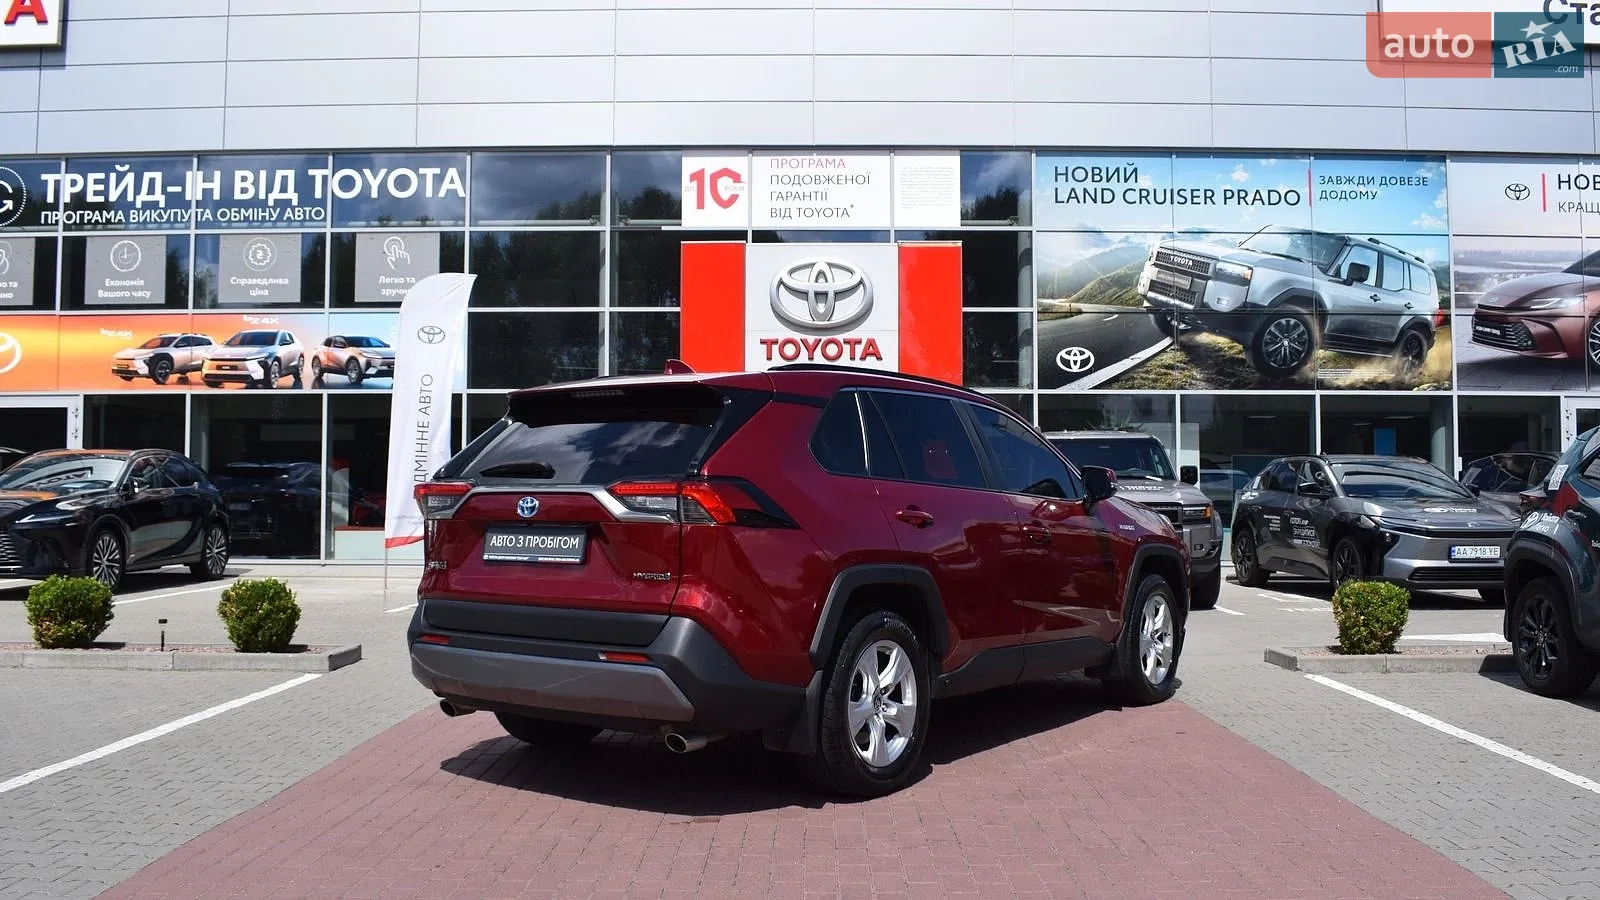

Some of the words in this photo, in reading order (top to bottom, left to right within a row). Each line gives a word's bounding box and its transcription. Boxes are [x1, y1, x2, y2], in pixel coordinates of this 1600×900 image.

[770, 158, 846, 168] ПРОГРАМА
[770, 172, 871, 187] ПОДОВЖЕНОЇ
[1054, 162, 1138, 183] НОВИЙ
[41, 165, 221, 208] ТРЕЙД-ІН
[234, 169, 298, 206] ВІД
[308, 168, 466, 199] TOYOTA
[1319, 175, 1375, 187] ЗАВЖДИ
[1379, 176, 1429, 187] ДОВЕЗЕ
[1557, 173, 1600, 190] НОВ
[770, 188, 829, 201] ГАРАНТІЇ
[1054, 187, 1115, 204] LAND
[1122, 188, 1216, 205] CRUISER
[1223, 189, 1301, 206] PRADO
[1319, 190, 1378, 201] ДОДОМУ
[41, 210, 125, 225] ПРОГРАМА
[130, 209, 192, 224] ВИКУПУ
[194, 208, 213, 222] ТА
[217, 207, 279, 222] ОБМІНУ
[283, 206, 325, 221] АВТО
[770, 207, 793, 220] ВІД
[105, 278, 145, 286] Економія
[98, 289, 130, 298] Вашого
[249, 288, 269, 296] ціна
[760, 337, 883, 362] TOYOTA
[418, 374, 434, 416] АВТО
[490, 535, 515, 547] АВТО
[516, 536, 524, 547] З
[525, 536, 579, 549] ПРОБІГОМ
